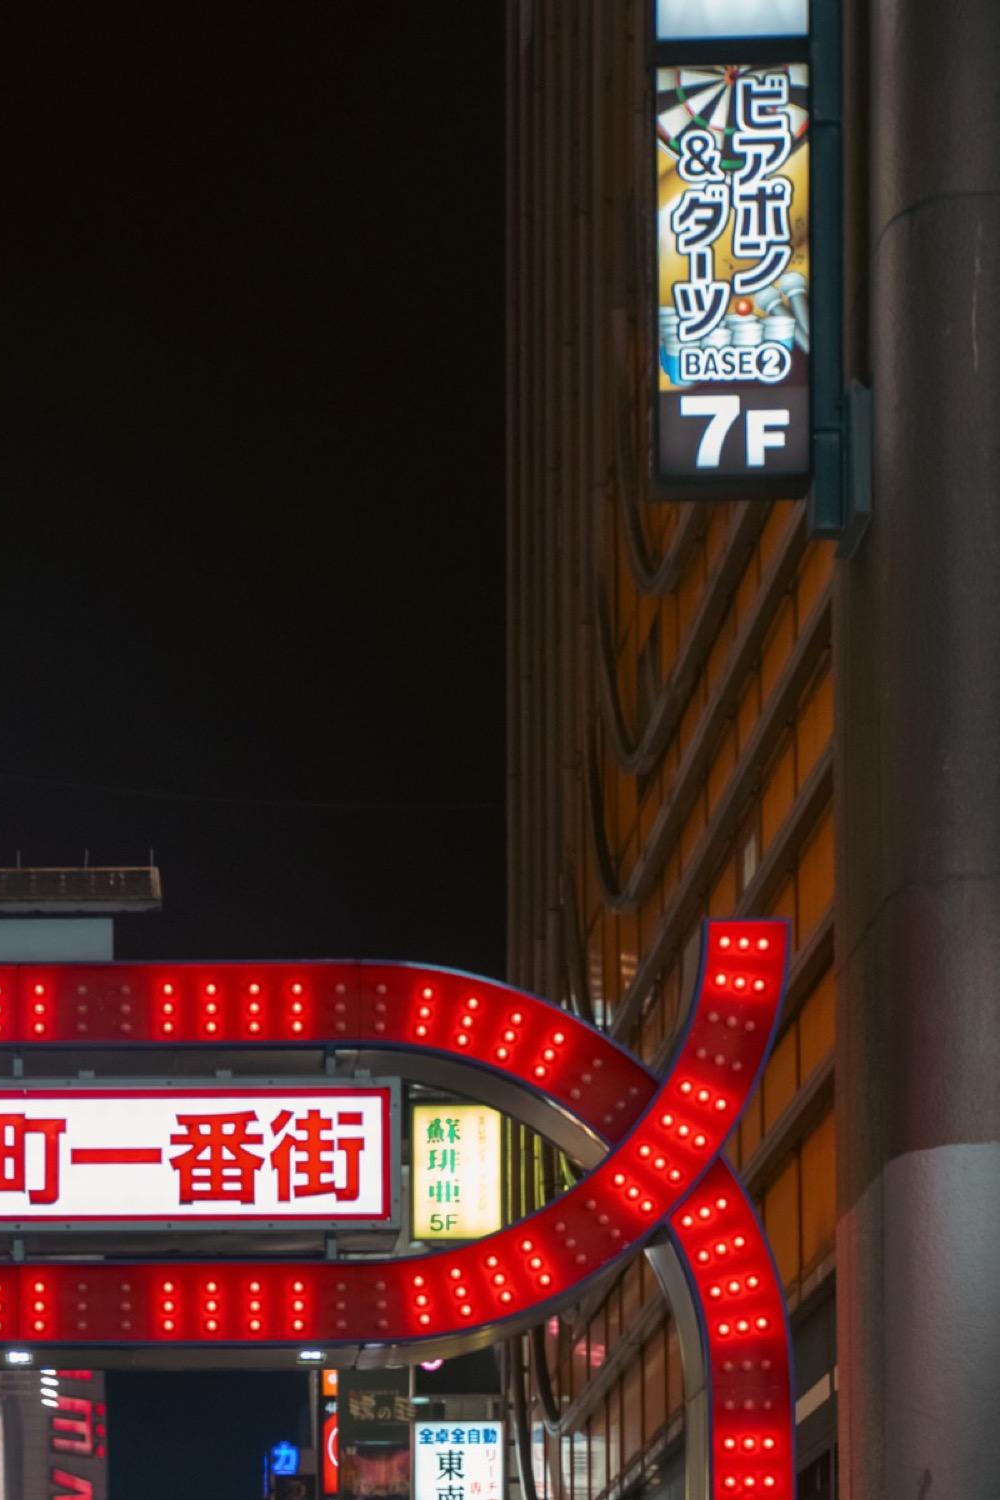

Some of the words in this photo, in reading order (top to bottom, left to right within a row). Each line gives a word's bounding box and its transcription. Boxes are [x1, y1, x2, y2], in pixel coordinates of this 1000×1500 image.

[734, 74, 791, 294] ビアポン
[681, 396, 789, 467] 7F
[430, 1214, 458, 1231] 5F
[419, 1428, 497, 1445] 全卓全自動
